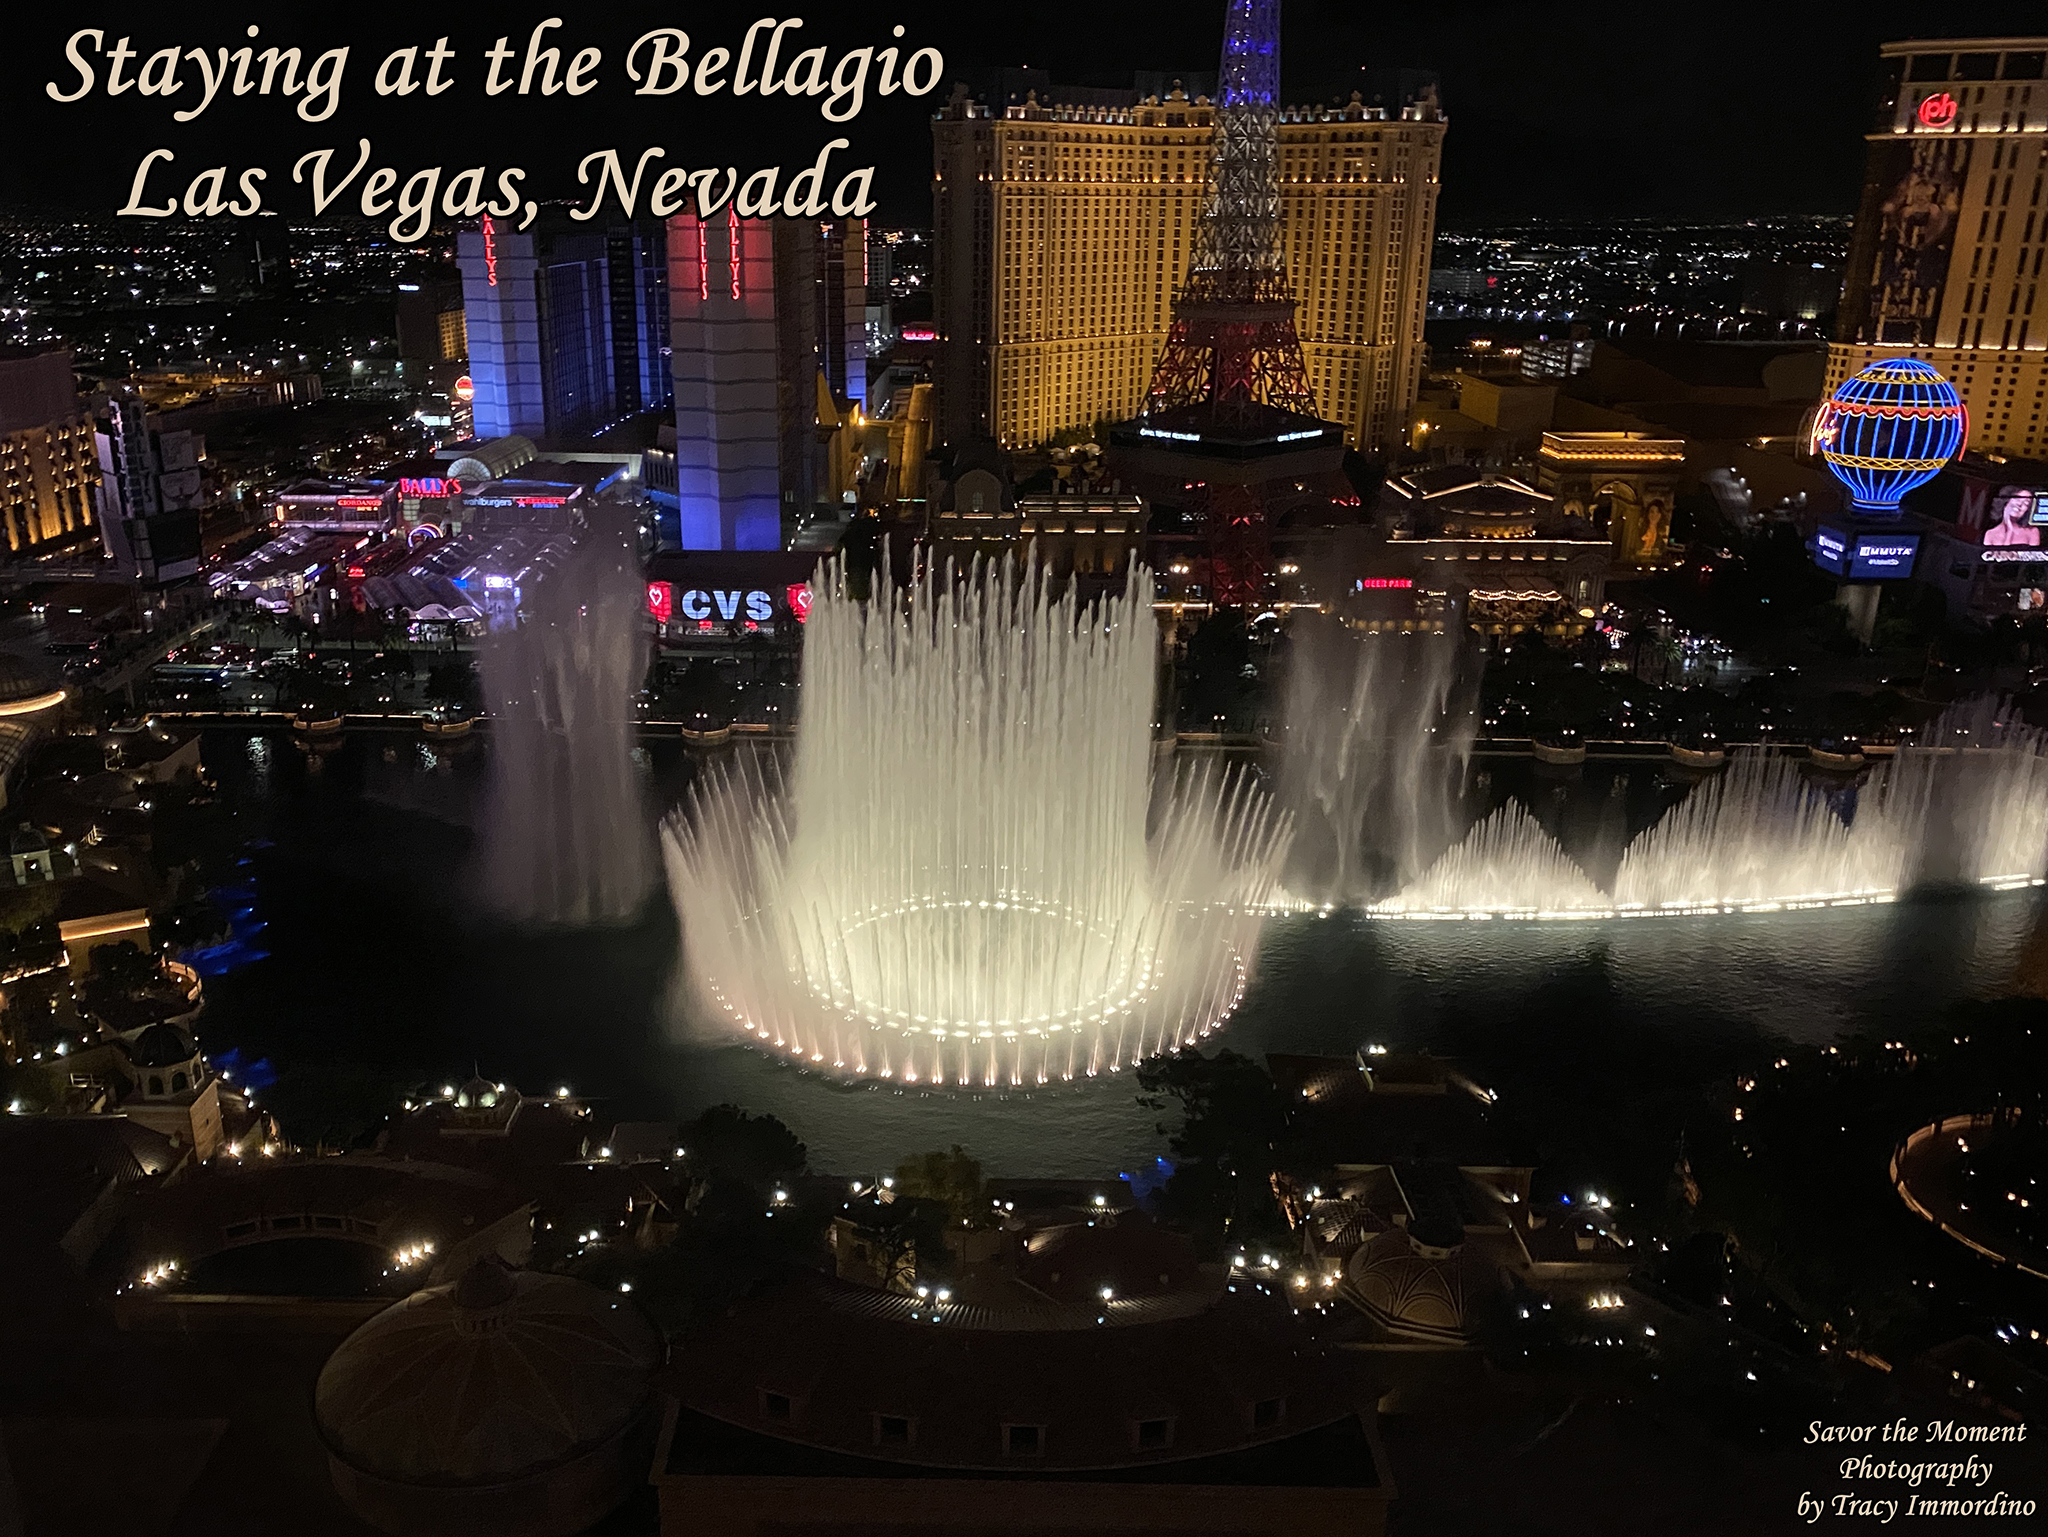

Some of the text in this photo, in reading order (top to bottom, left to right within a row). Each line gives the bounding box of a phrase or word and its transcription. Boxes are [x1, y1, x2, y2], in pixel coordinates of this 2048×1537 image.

[699, 220, 709, 300] LLYS
[728, 200, 741, 300] ALLYS
[399, 477, 463, 494] BALLY'S
[681, 589, 773, 621] CVS
